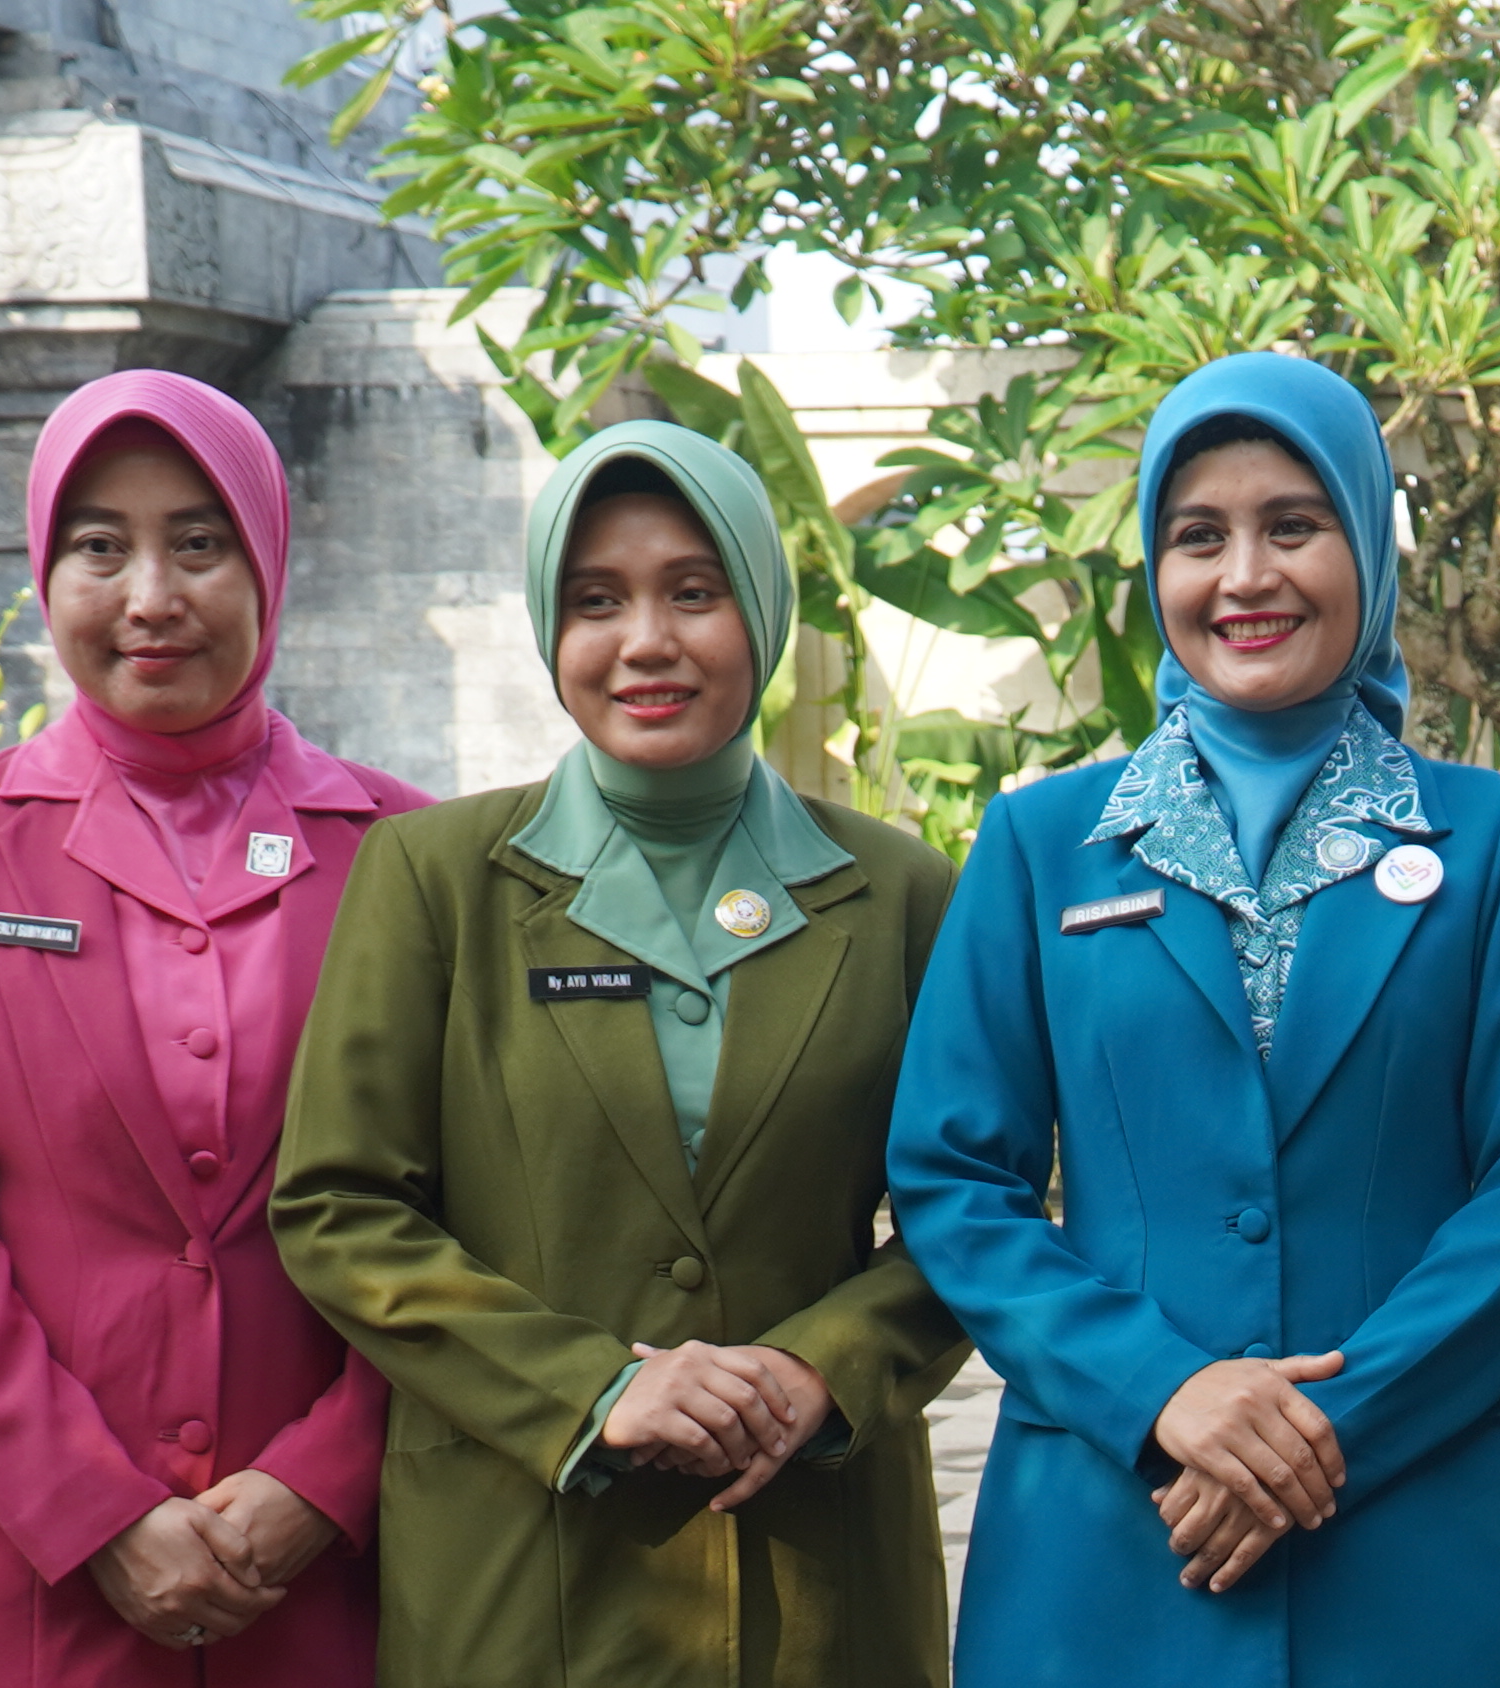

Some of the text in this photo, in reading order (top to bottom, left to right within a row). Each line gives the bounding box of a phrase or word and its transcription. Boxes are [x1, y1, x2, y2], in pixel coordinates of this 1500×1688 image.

[1075, 896, 1147, 923] RISA IBIN
[566, 974, 587, 988] AYU
